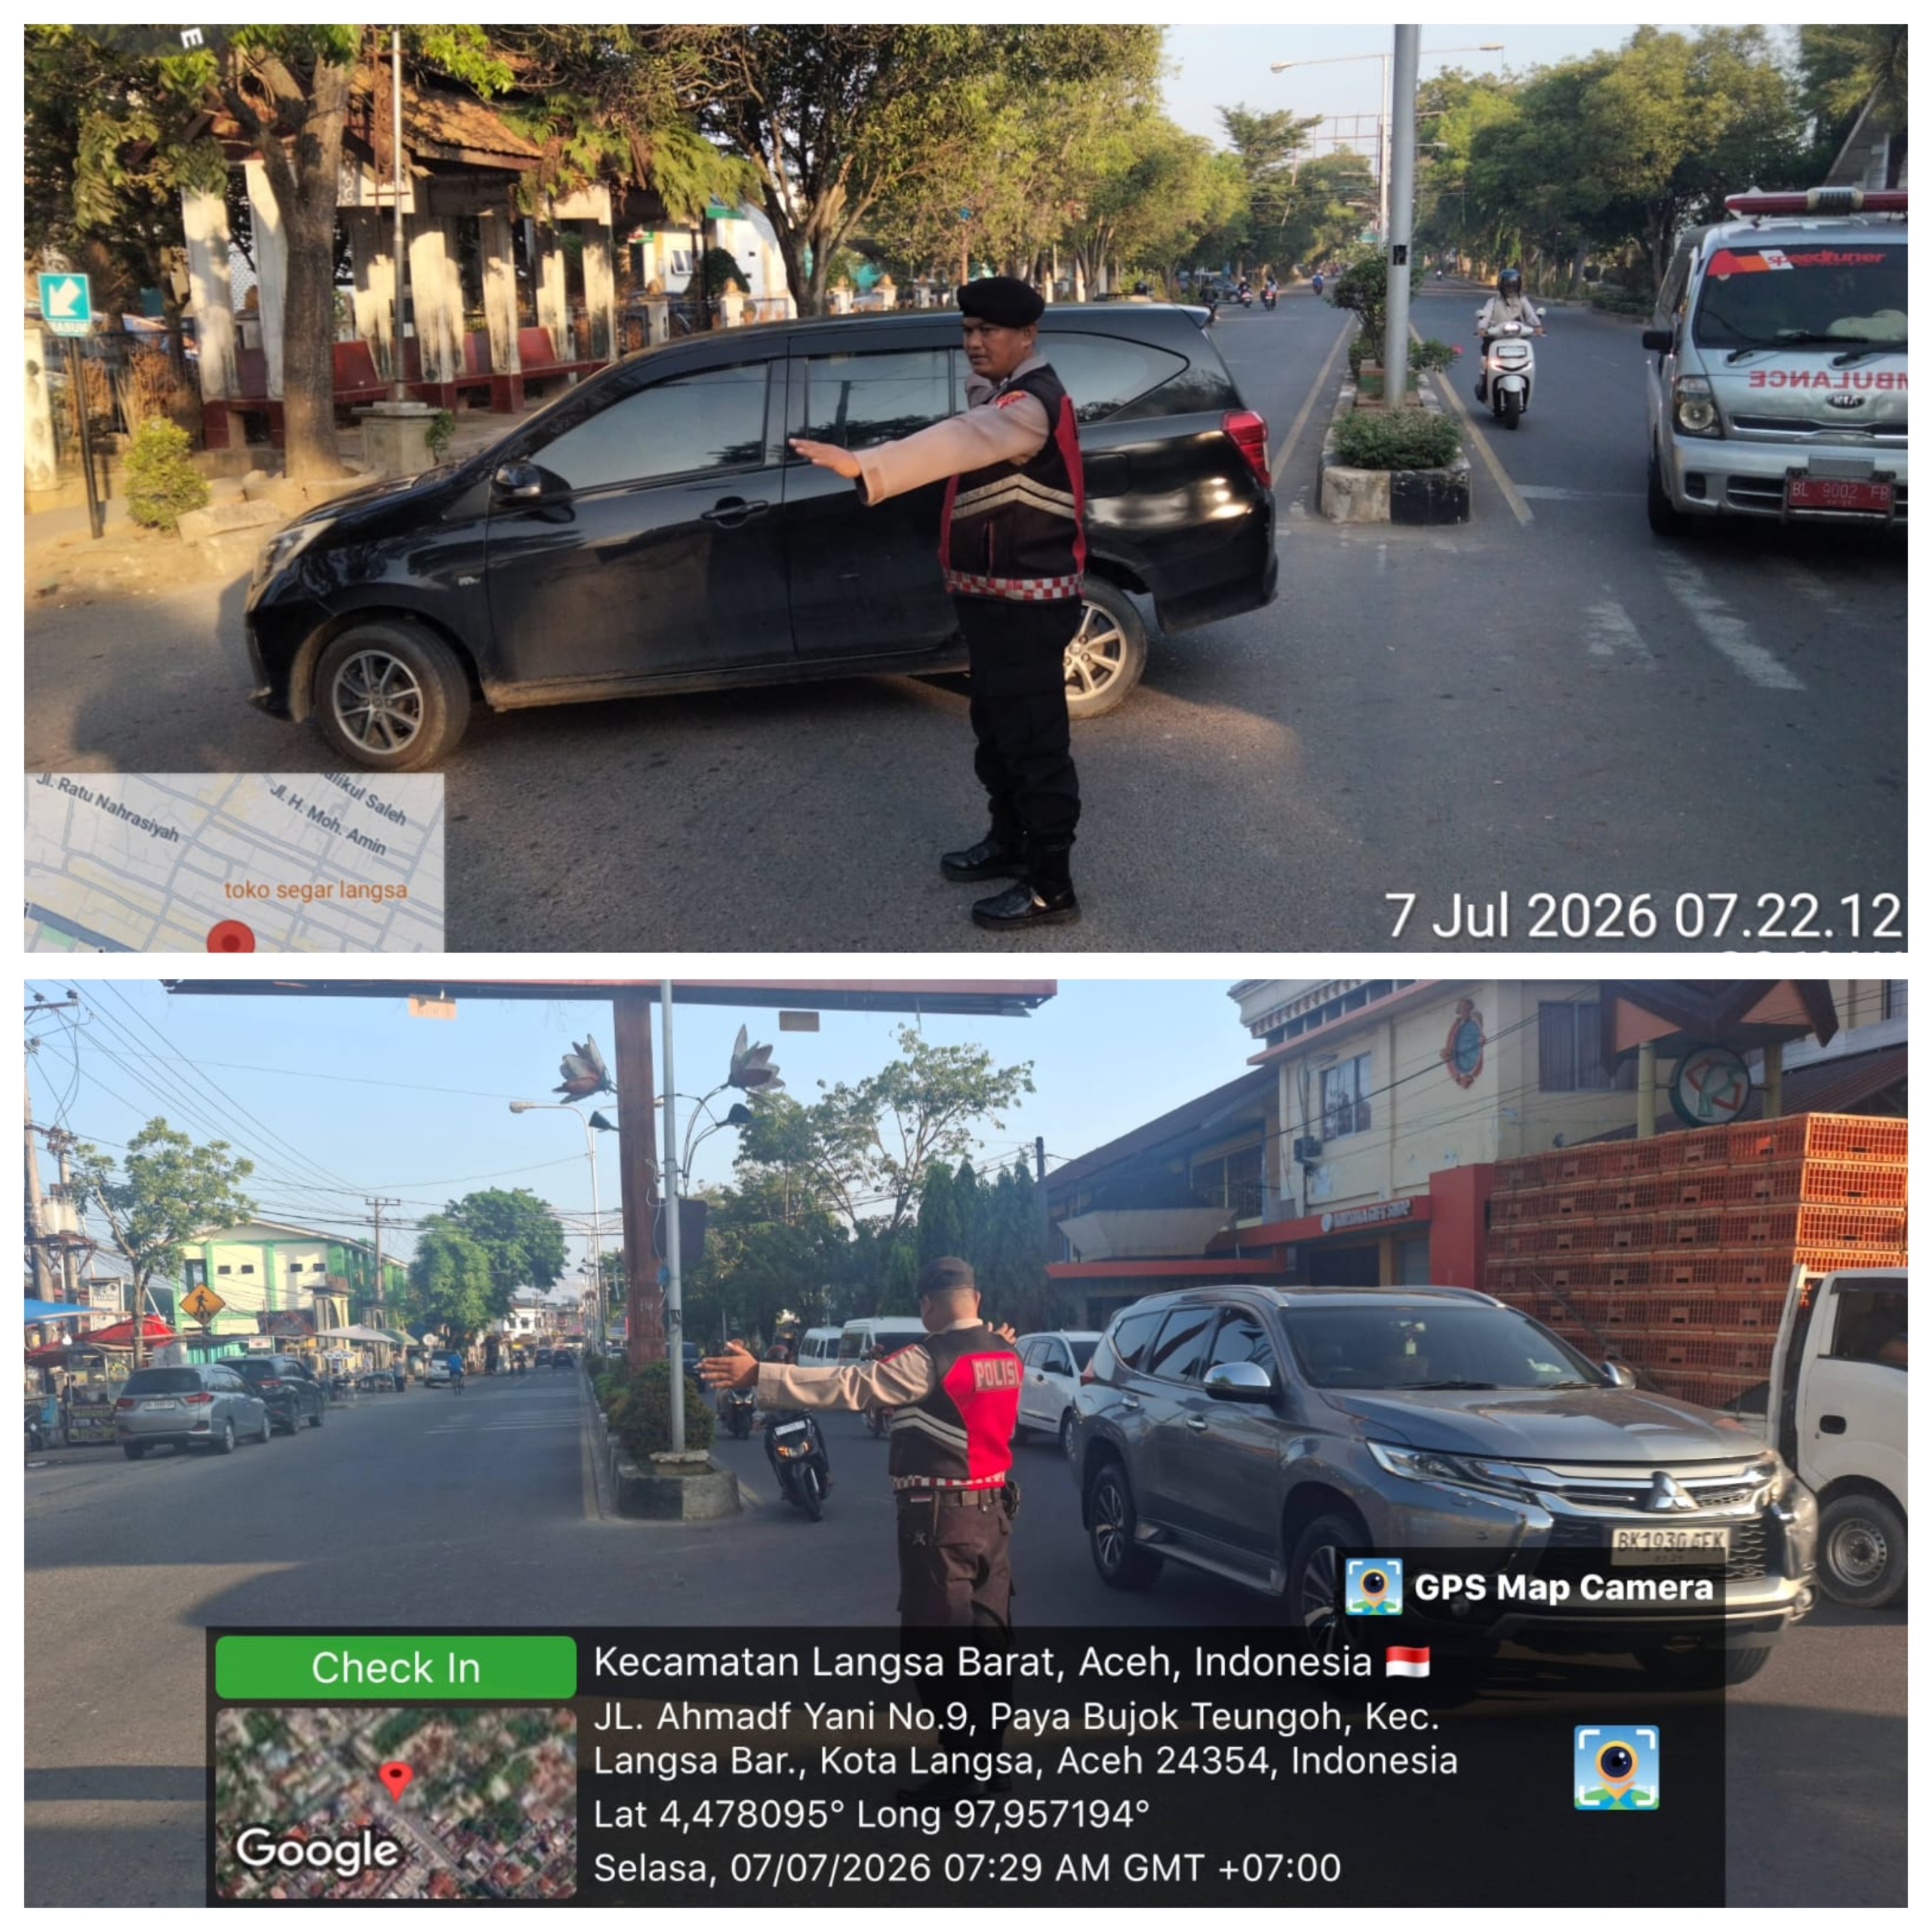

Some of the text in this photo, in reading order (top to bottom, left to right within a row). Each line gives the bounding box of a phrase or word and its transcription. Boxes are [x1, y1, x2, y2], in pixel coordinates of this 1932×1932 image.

[1792, 481, 1810, 497] BL
[1822, 483, 1858, 499] 9002
[1617, 1532, 1639, 1552] BK
[1641, 1532, 1687, 1552] 1930
